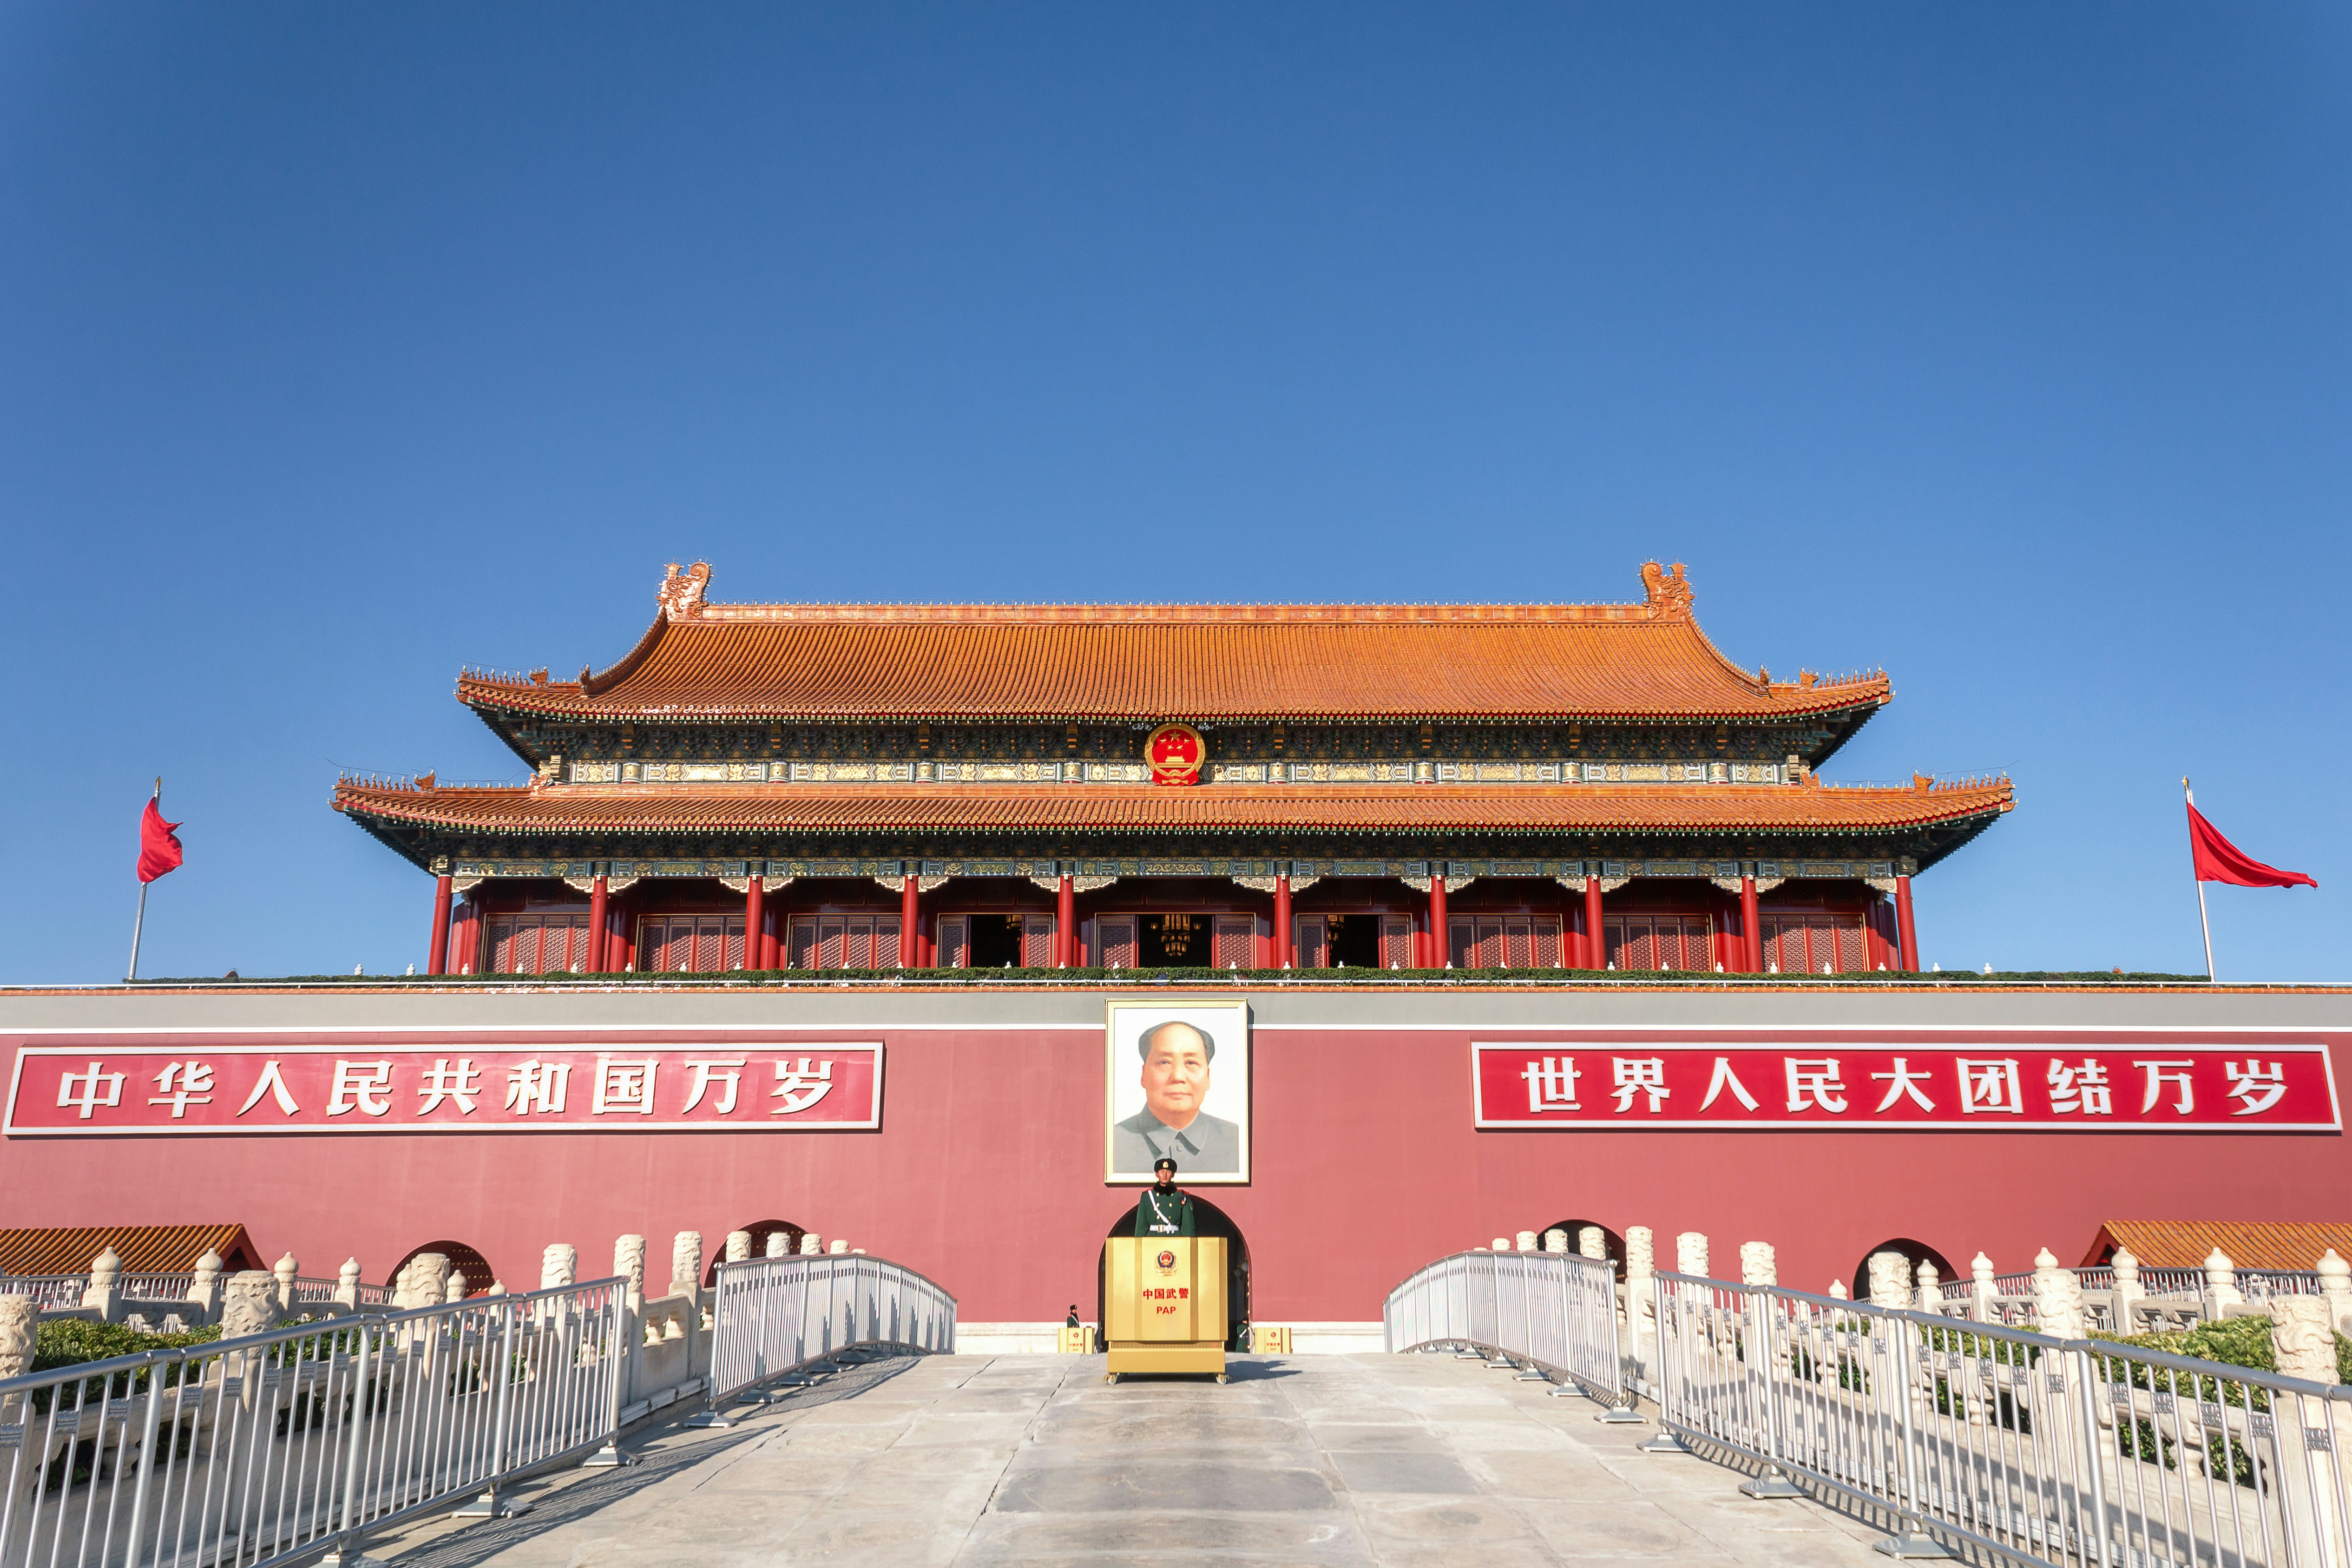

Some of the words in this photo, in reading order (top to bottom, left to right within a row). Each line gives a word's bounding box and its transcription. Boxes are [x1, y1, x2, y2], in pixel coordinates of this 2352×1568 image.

[57, 1058, 833, 1119] 中华人民共和国万岁
[1521, 1057, 2288, 1115] 世界人民大团结万岁
[1143, 1288, 1189, 1300] 中国武警
[1156, 1306, 1176, 1314] PAP
